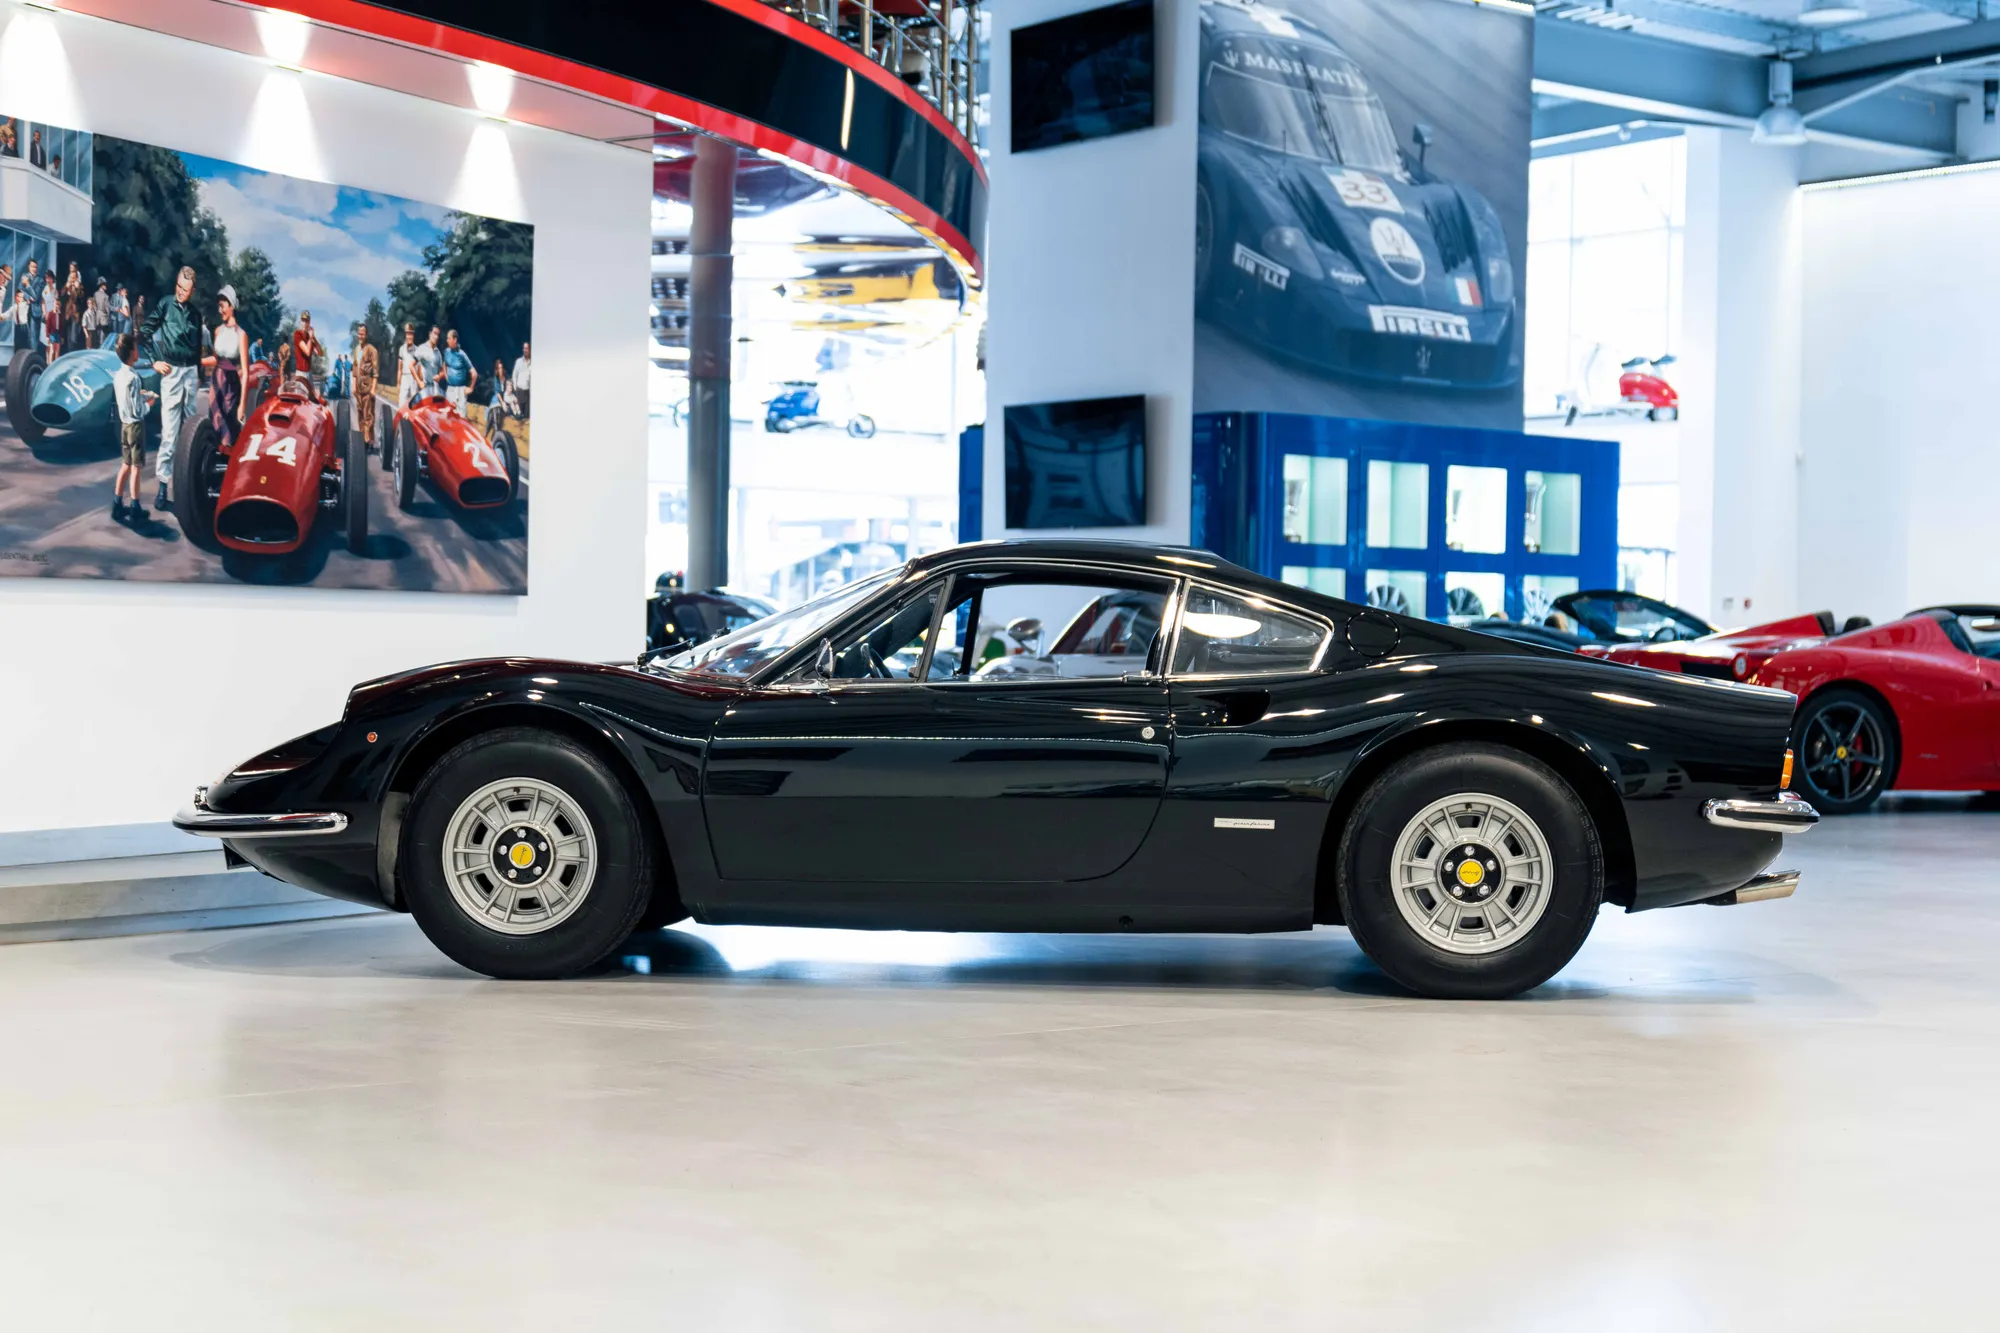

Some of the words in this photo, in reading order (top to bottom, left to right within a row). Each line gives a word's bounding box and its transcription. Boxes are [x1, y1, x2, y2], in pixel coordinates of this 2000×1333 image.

[1341, 180, 1388, 205] 33
[1233, 242, 1290, 291] PIRLLI
[1368, 304, 1471, 342] PIRELLI
[62, 375, 94, 403] 18
[239, 433, 297, 467] 14
